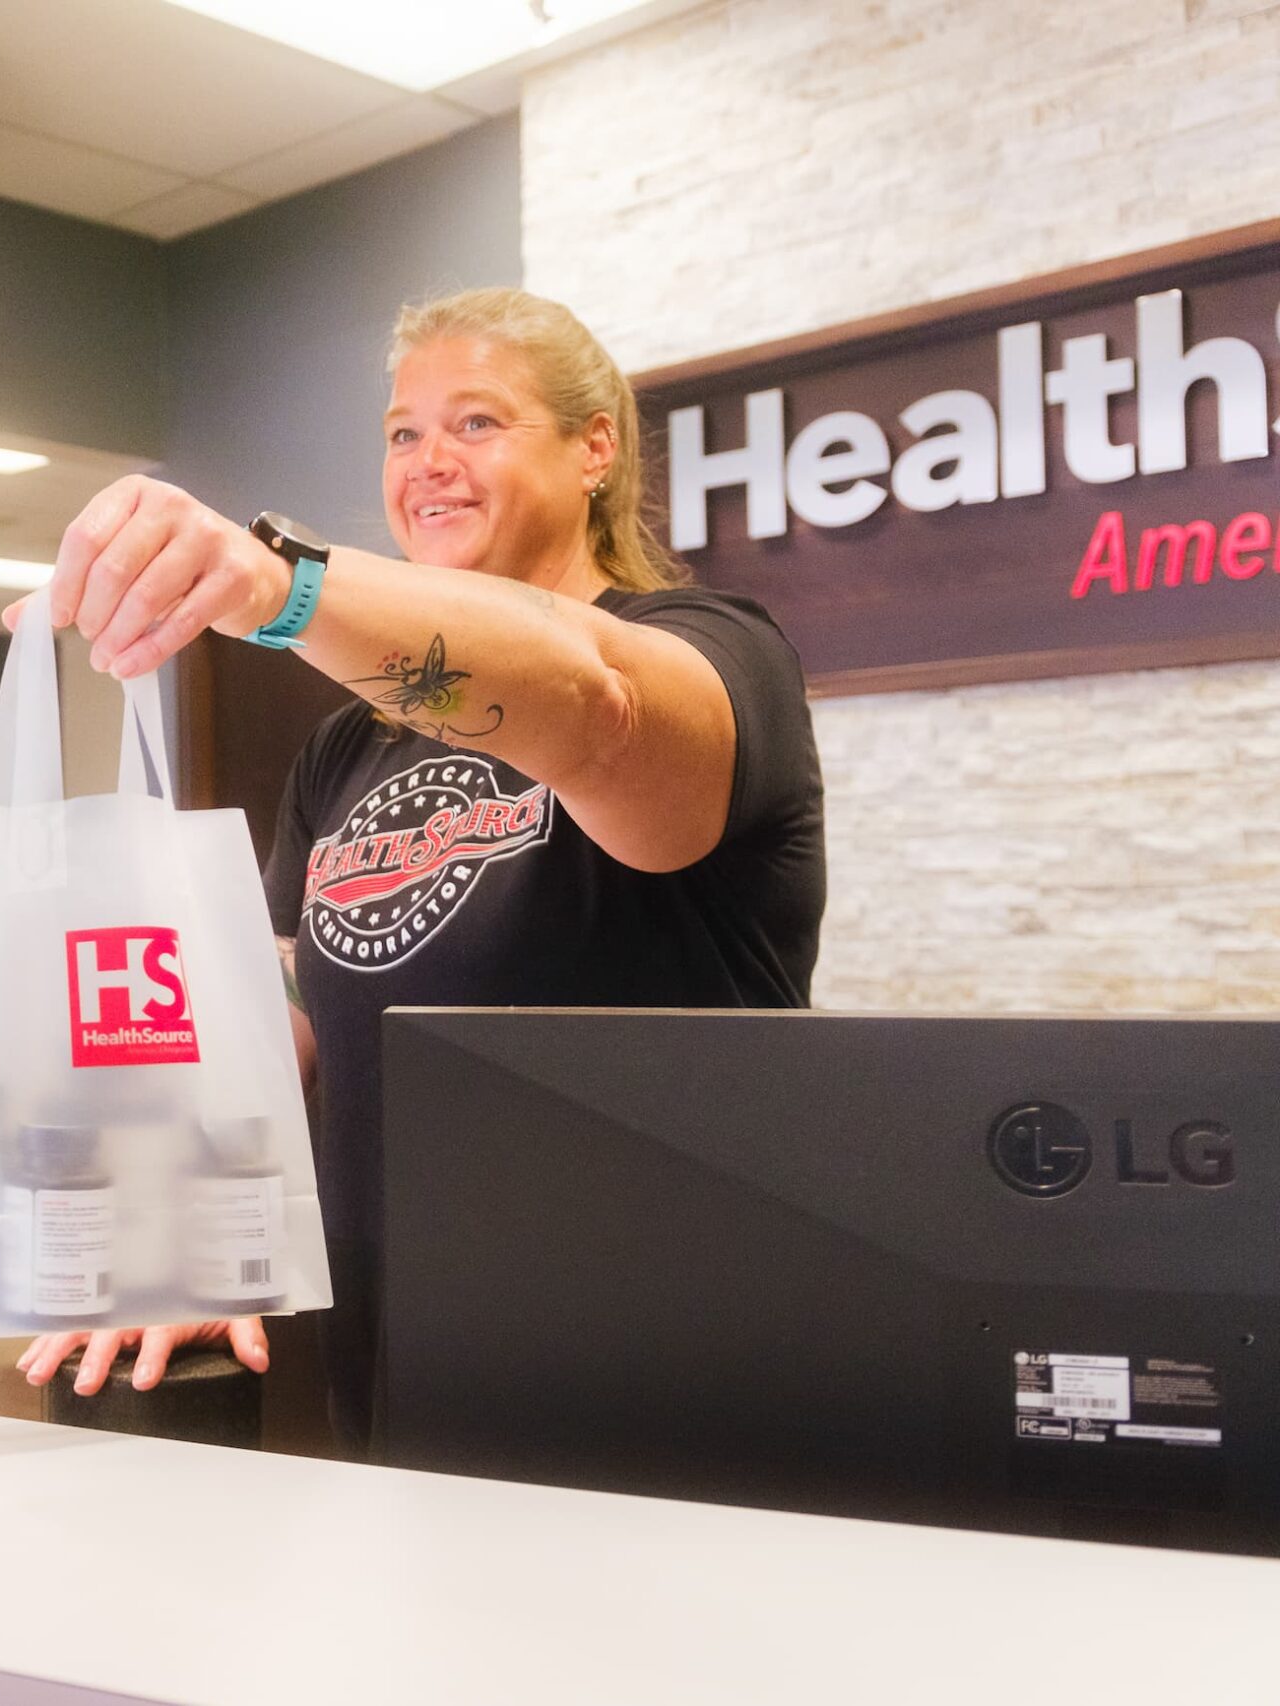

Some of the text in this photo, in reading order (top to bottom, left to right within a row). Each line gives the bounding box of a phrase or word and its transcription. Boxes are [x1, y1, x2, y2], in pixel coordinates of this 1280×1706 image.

[668, 288, 1280, 552] Health
[1070, 511, 1280, 600] Ame
[350, 765, 487, 832] AMERICA'
[317, 864, 473, 959] CHIROPRACTOR
[75, 937, 192, 1024] HS
[82, 1027, 193, 1047] HealthSource
[1114, 1118, 1237, 1189] LG
[1030, 1354, 1048, 1365] LG
